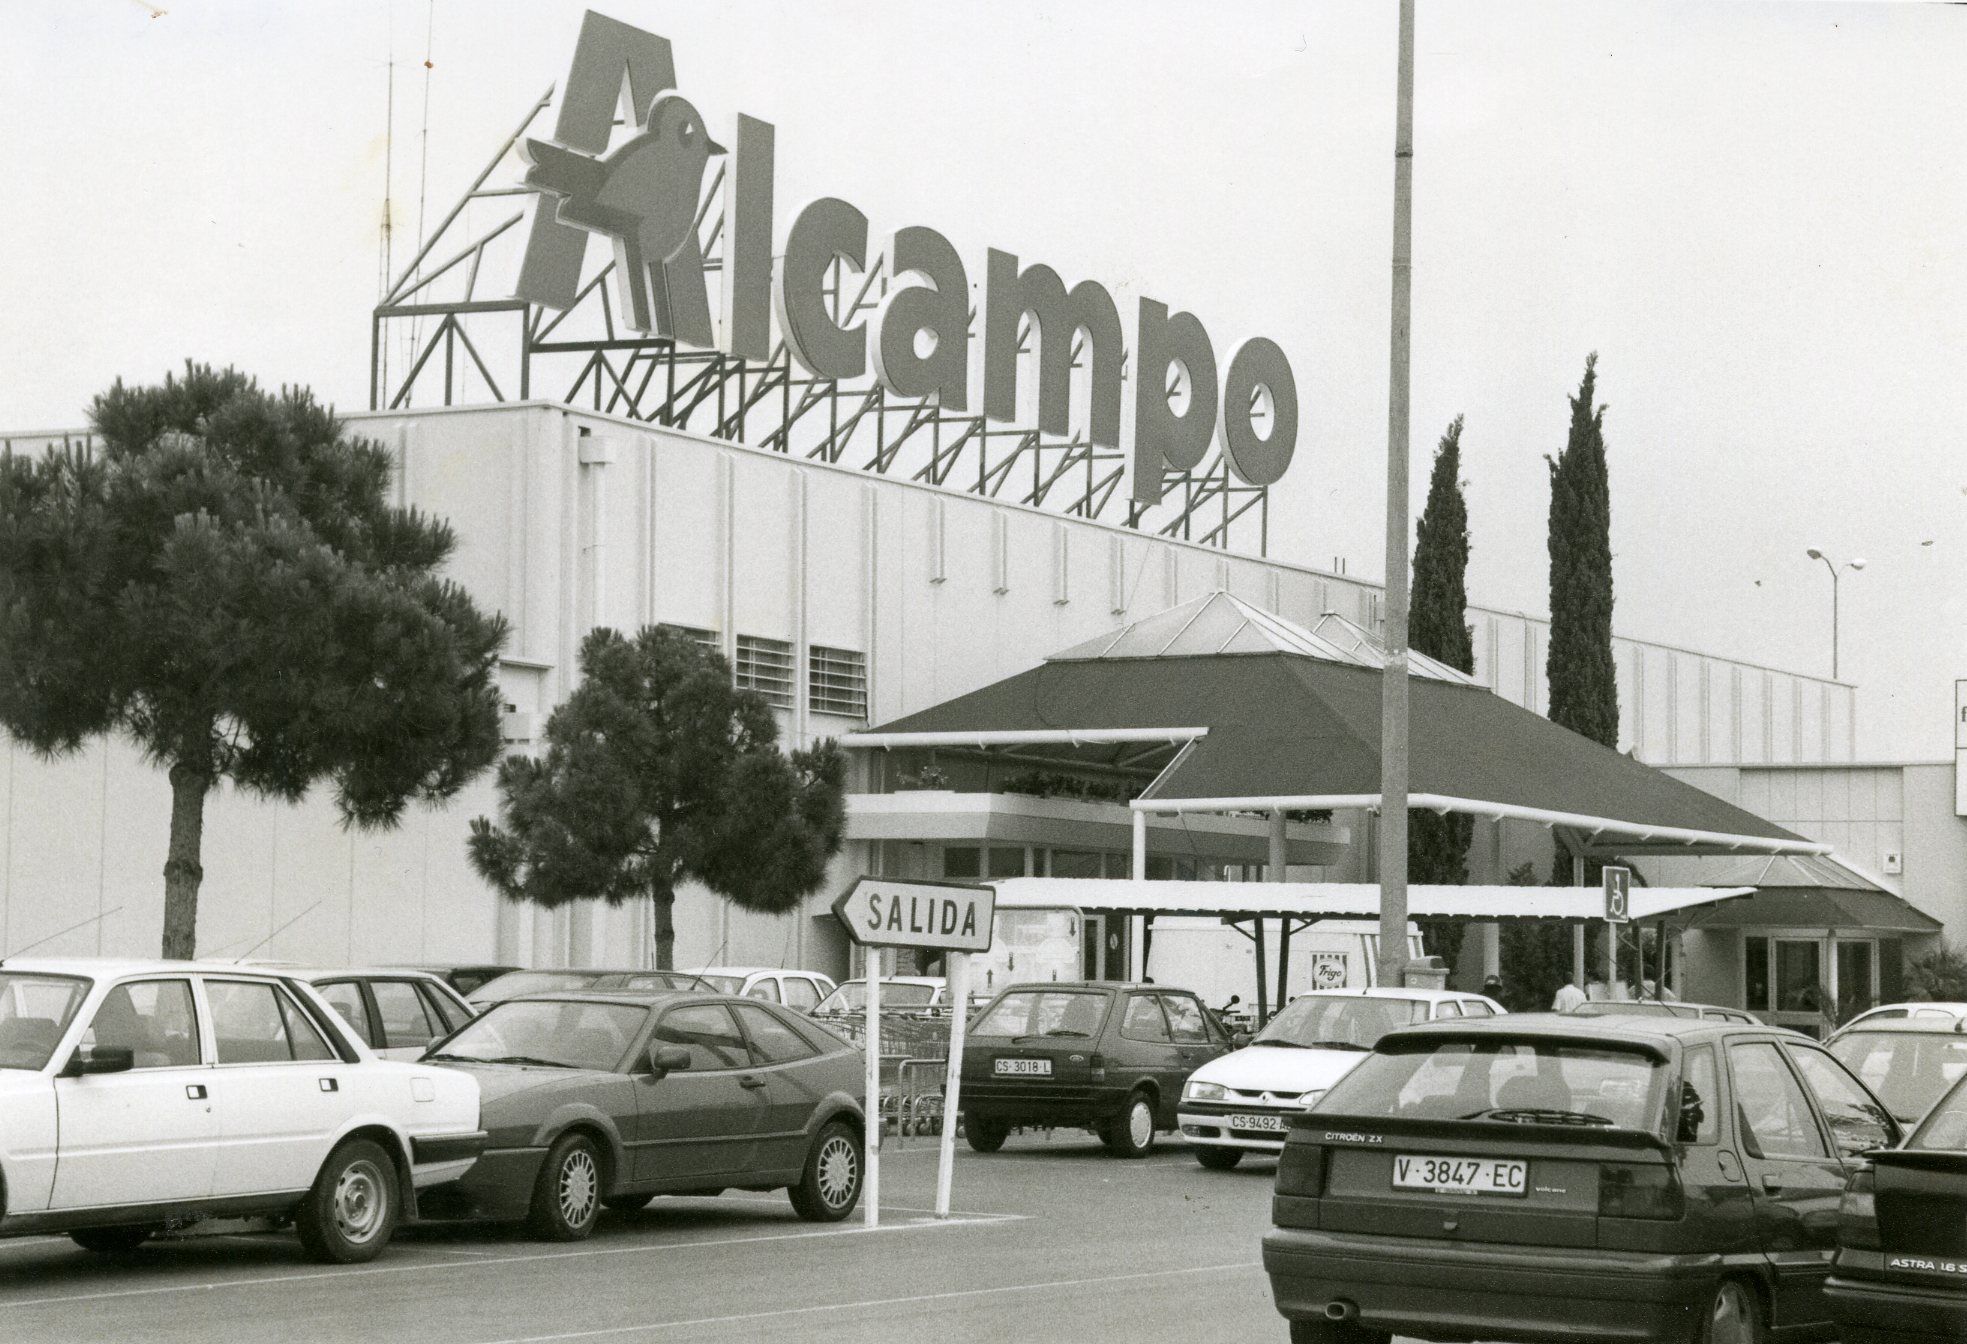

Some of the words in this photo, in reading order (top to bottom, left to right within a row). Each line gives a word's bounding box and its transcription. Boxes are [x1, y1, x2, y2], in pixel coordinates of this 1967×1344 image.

[515, 8, 1298, 505] Alcampo
[867, 893, 977, 937] SALIDA
[1319, 964, 1342, 981] Frigo
[1368, 1135, 1383, 1144] ZX
[1890, 1258, 1936, 1270] ASTRA
